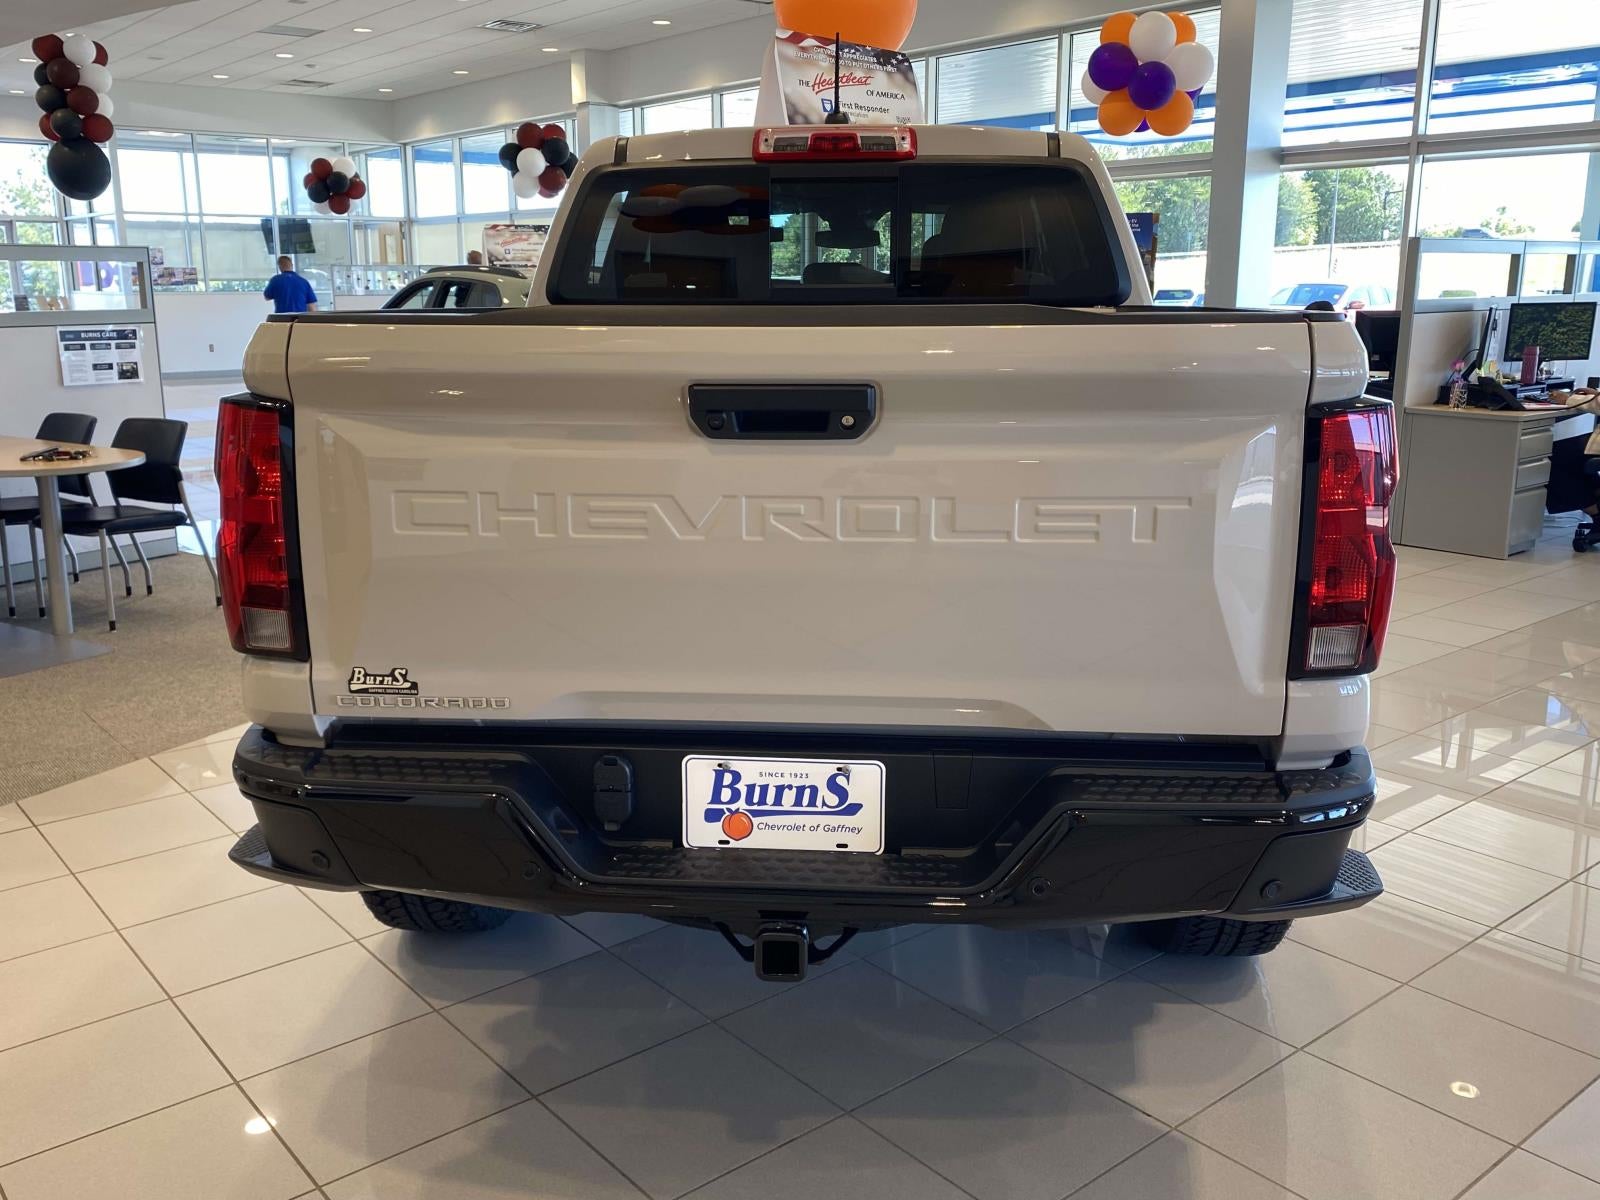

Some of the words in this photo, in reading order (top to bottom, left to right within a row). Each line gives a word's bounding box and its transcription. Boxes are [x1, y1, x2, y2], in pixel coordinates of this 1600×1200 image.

[843, 53, 877, 62] APPRECIATES
[863, 62, 883, 71] OTHERS
[883, 65, 897, 73] FIRST
[798, 79, 810, 87] THE
[811, 71, 875, 92] Heatbeat
[866, 89, 875, 97] OF
[875, 90, 906, 101] AMERICA
[854, 102, 890, 114] Responder
[391, 490, 1192, 543] CHEVROLET
[336, 695, 510, 709] COLORADO
[756, 822, 806, 832] Chevrolet
[809, 823, 820, 832] of
[822, 823, 863, 835] Gaffney
